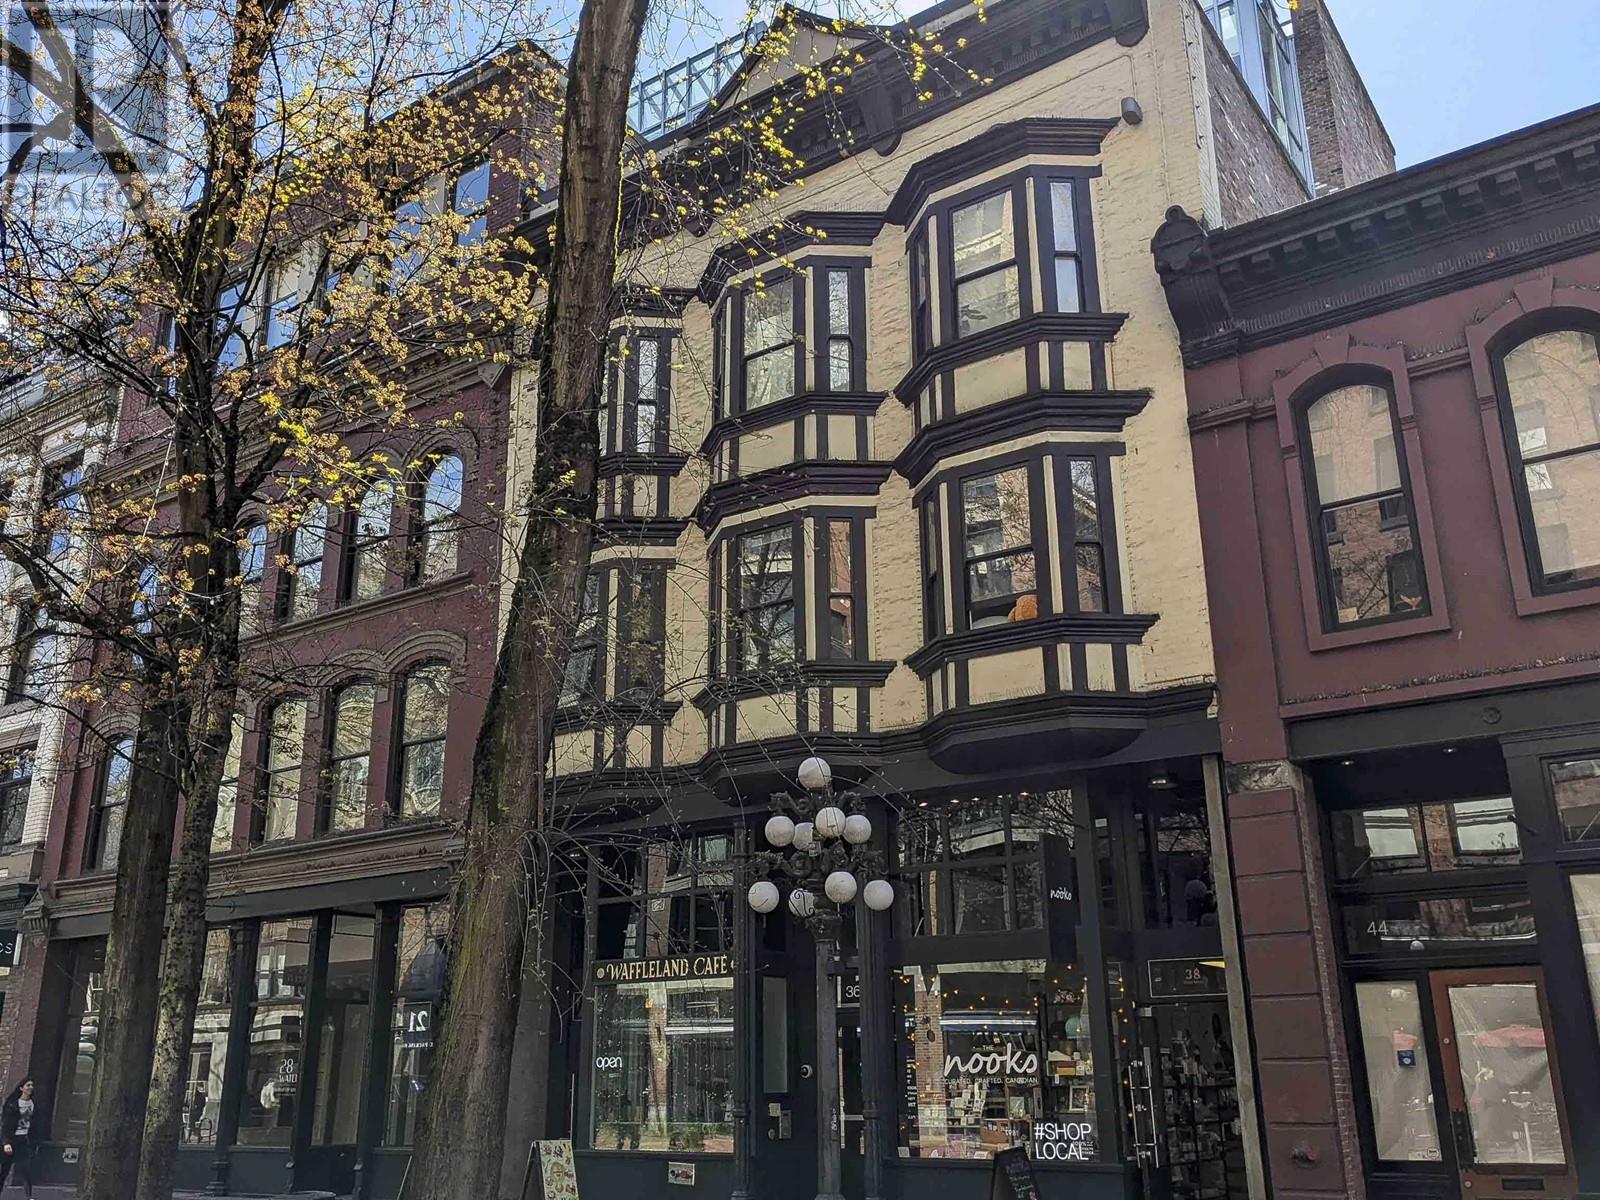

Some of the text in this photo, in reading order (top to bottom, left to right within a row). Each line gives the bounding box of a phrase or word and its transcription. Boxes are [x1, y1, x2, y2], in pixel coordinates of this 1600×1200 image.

[1367, 920, 1389, 936] 44
[606, 954, 728, 980] WAFFLELAND CAFÉ
[1185, 968, 1201, 980] 38
[845, 985, 860, 998] 36
[280, 1058, 294, 1074] 28
[595, 1056, 623, 1071] open
[944, 1042, 1038, 1077] nooks
[1034, 1122, 1092, 1140] #SHOP
[1035, 1142, 1089, 1160] LOCAL
